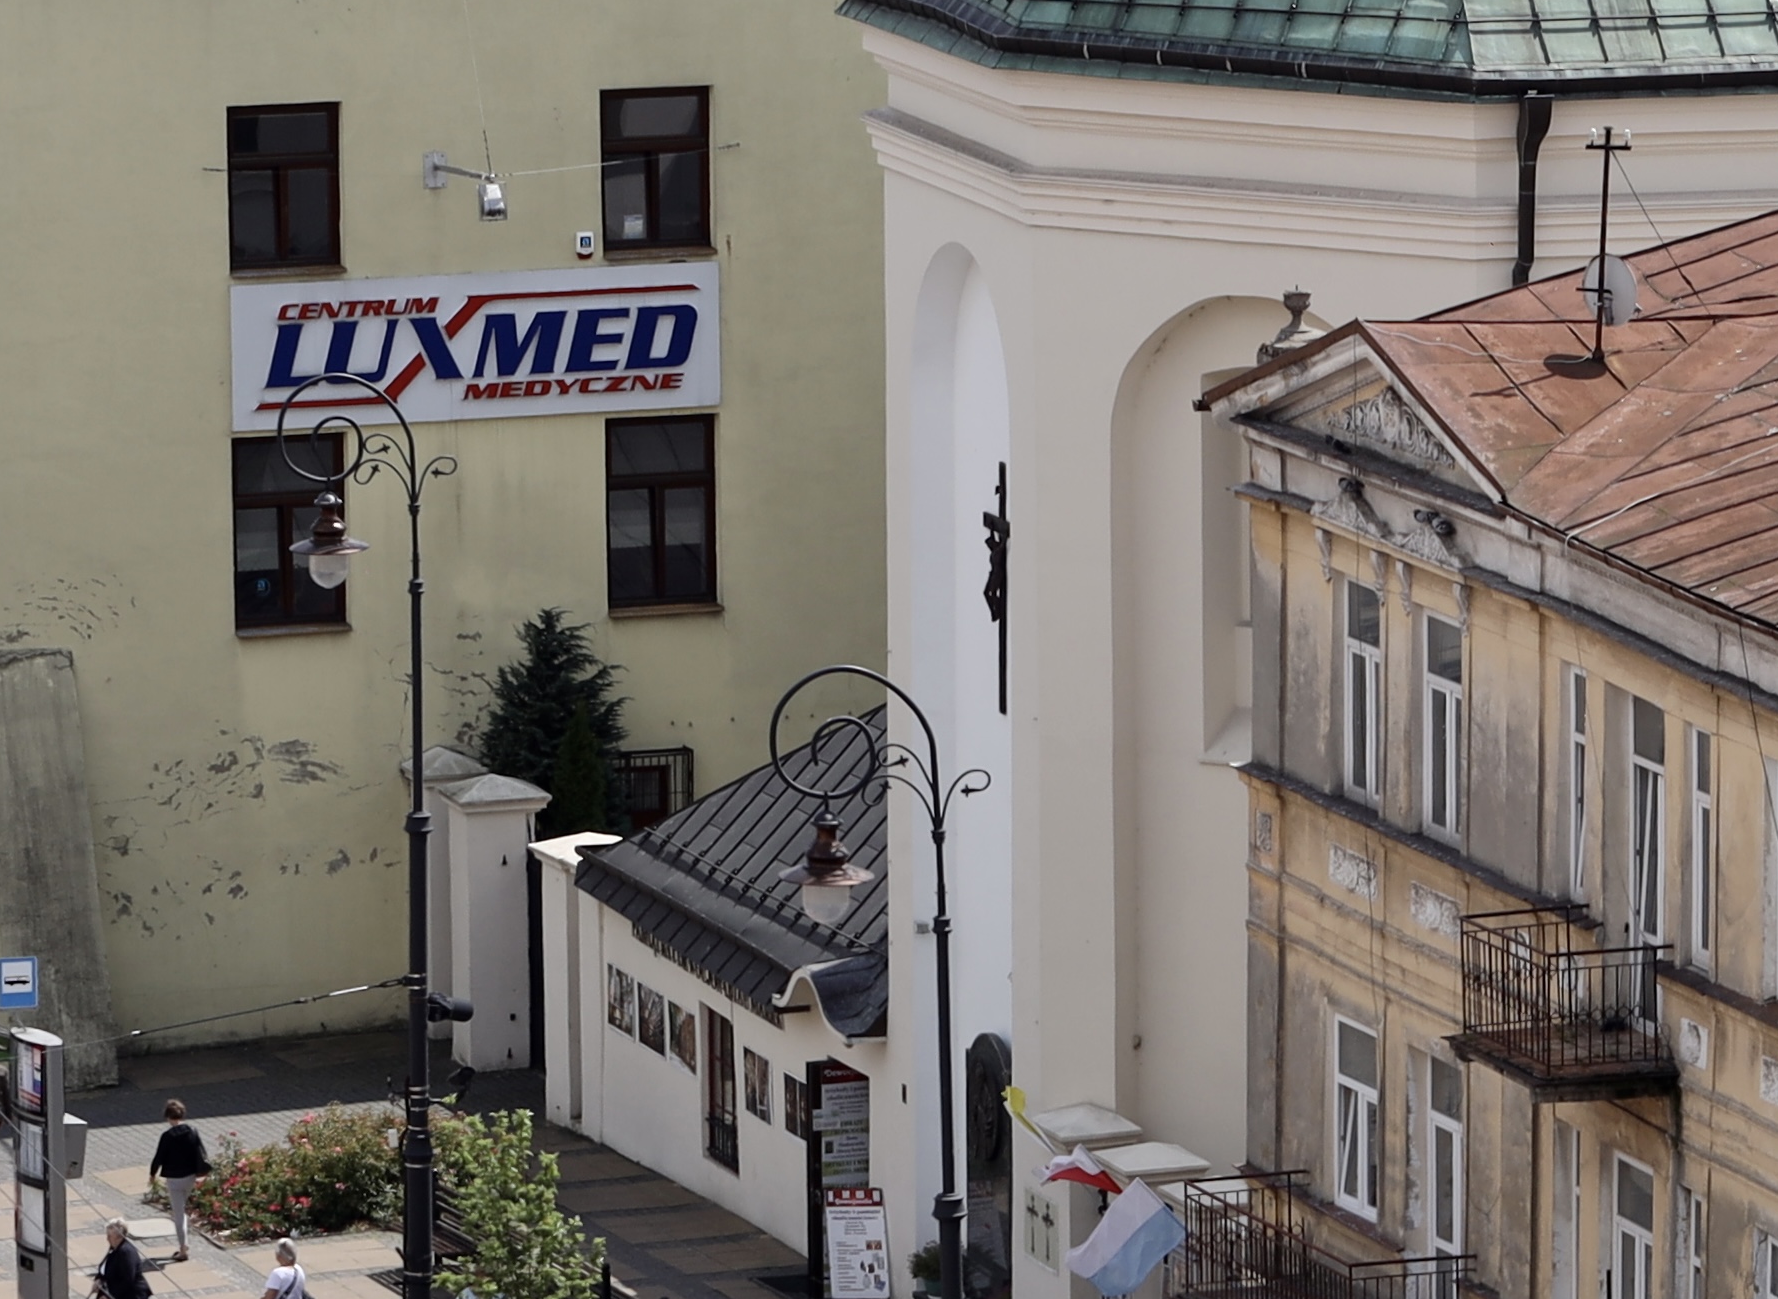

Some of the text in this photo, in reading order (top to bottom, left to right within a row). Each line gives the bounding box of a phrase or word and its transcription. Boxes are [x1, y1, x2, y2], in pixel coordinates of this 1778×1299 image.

[277, 297, 440, 321] CENTRUM
[263, 303, 700, 390] LUXMED
[462, 372, 685, 401] MEDYCZNE
